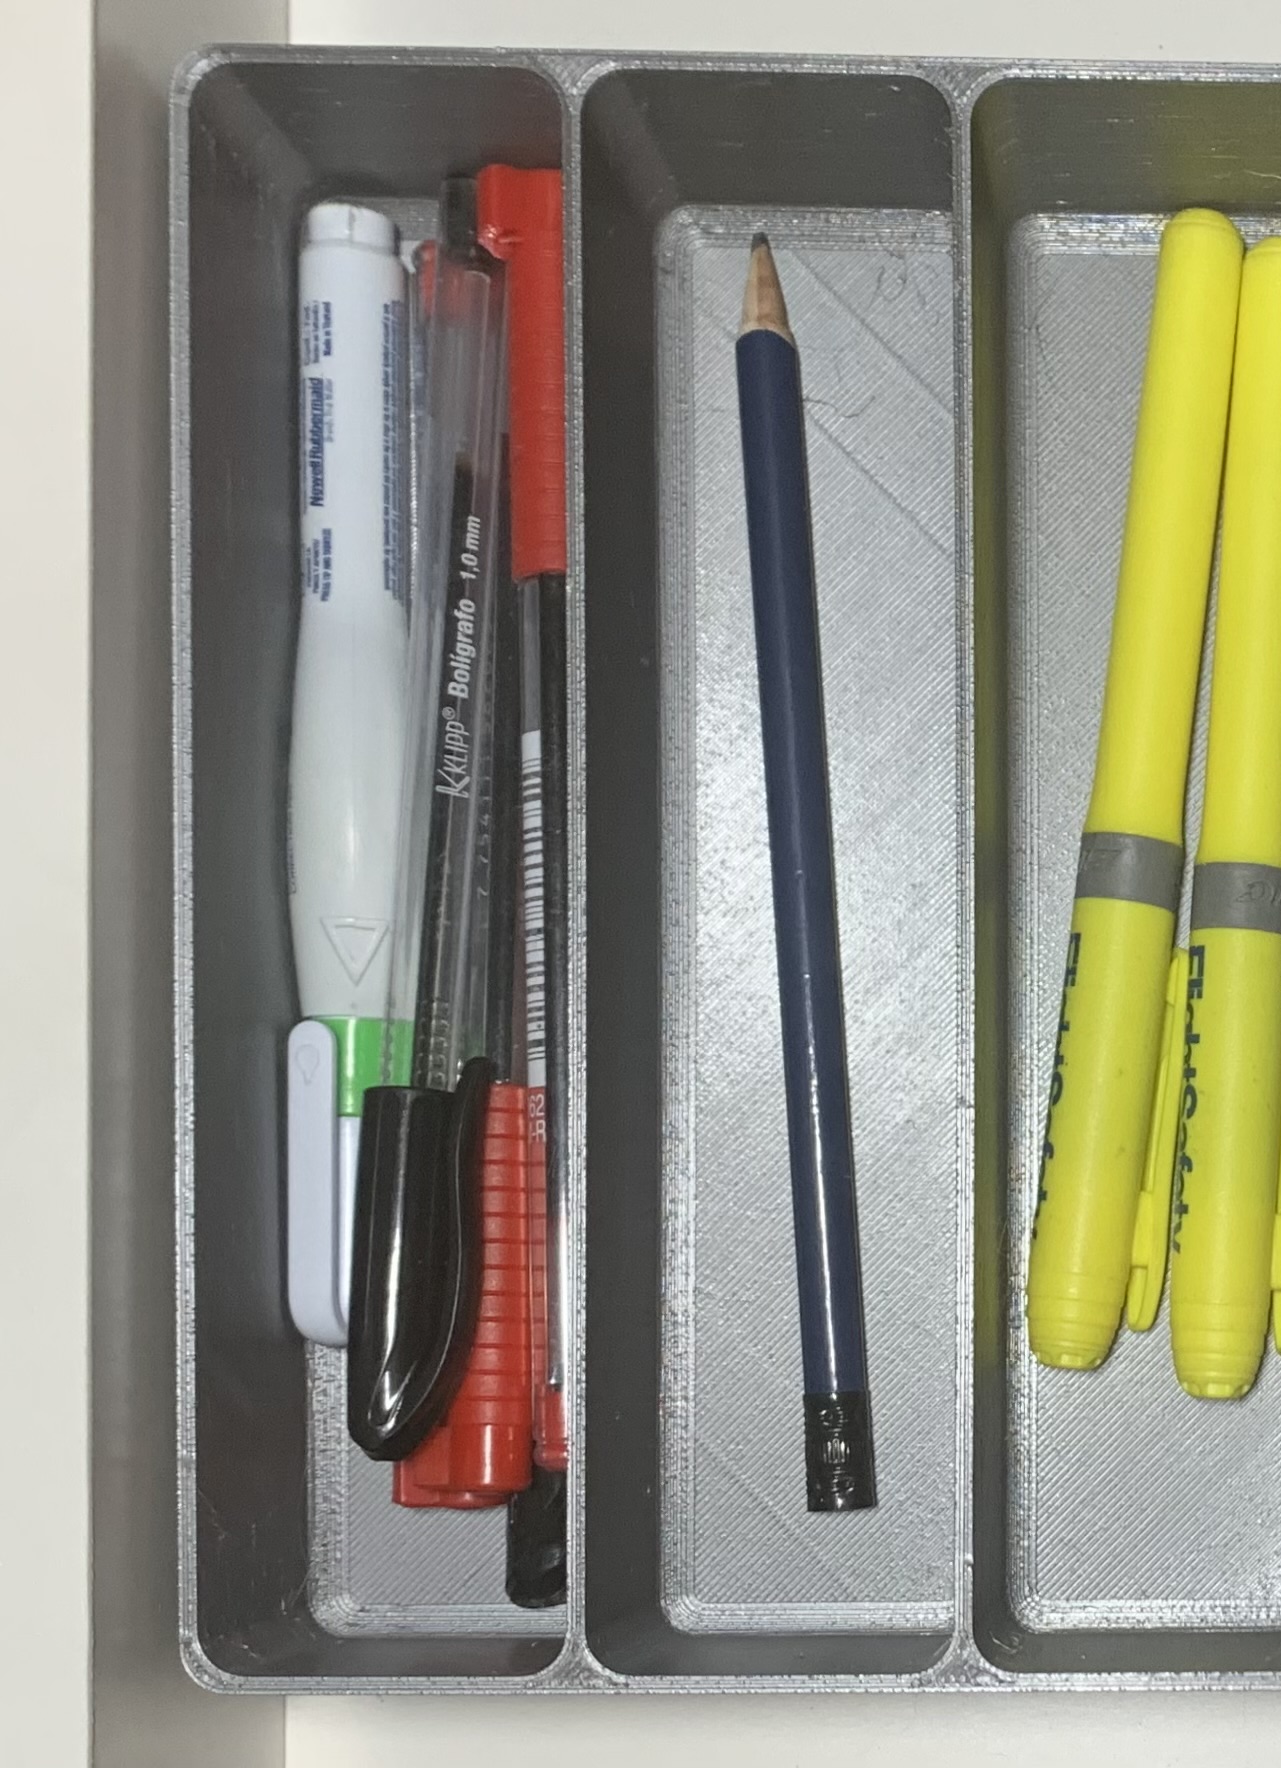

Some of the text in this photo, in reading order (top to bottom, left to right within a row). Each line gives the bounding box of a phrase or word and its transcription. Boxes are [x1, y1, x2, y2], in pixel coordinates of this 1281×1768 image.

[307, 377, 325, 459] Rubbermaid
[463, 514, 481, 551] mm
[459, 554, 481, 582] 1,0
[447, 598, 477, 699] Bolígrafo
